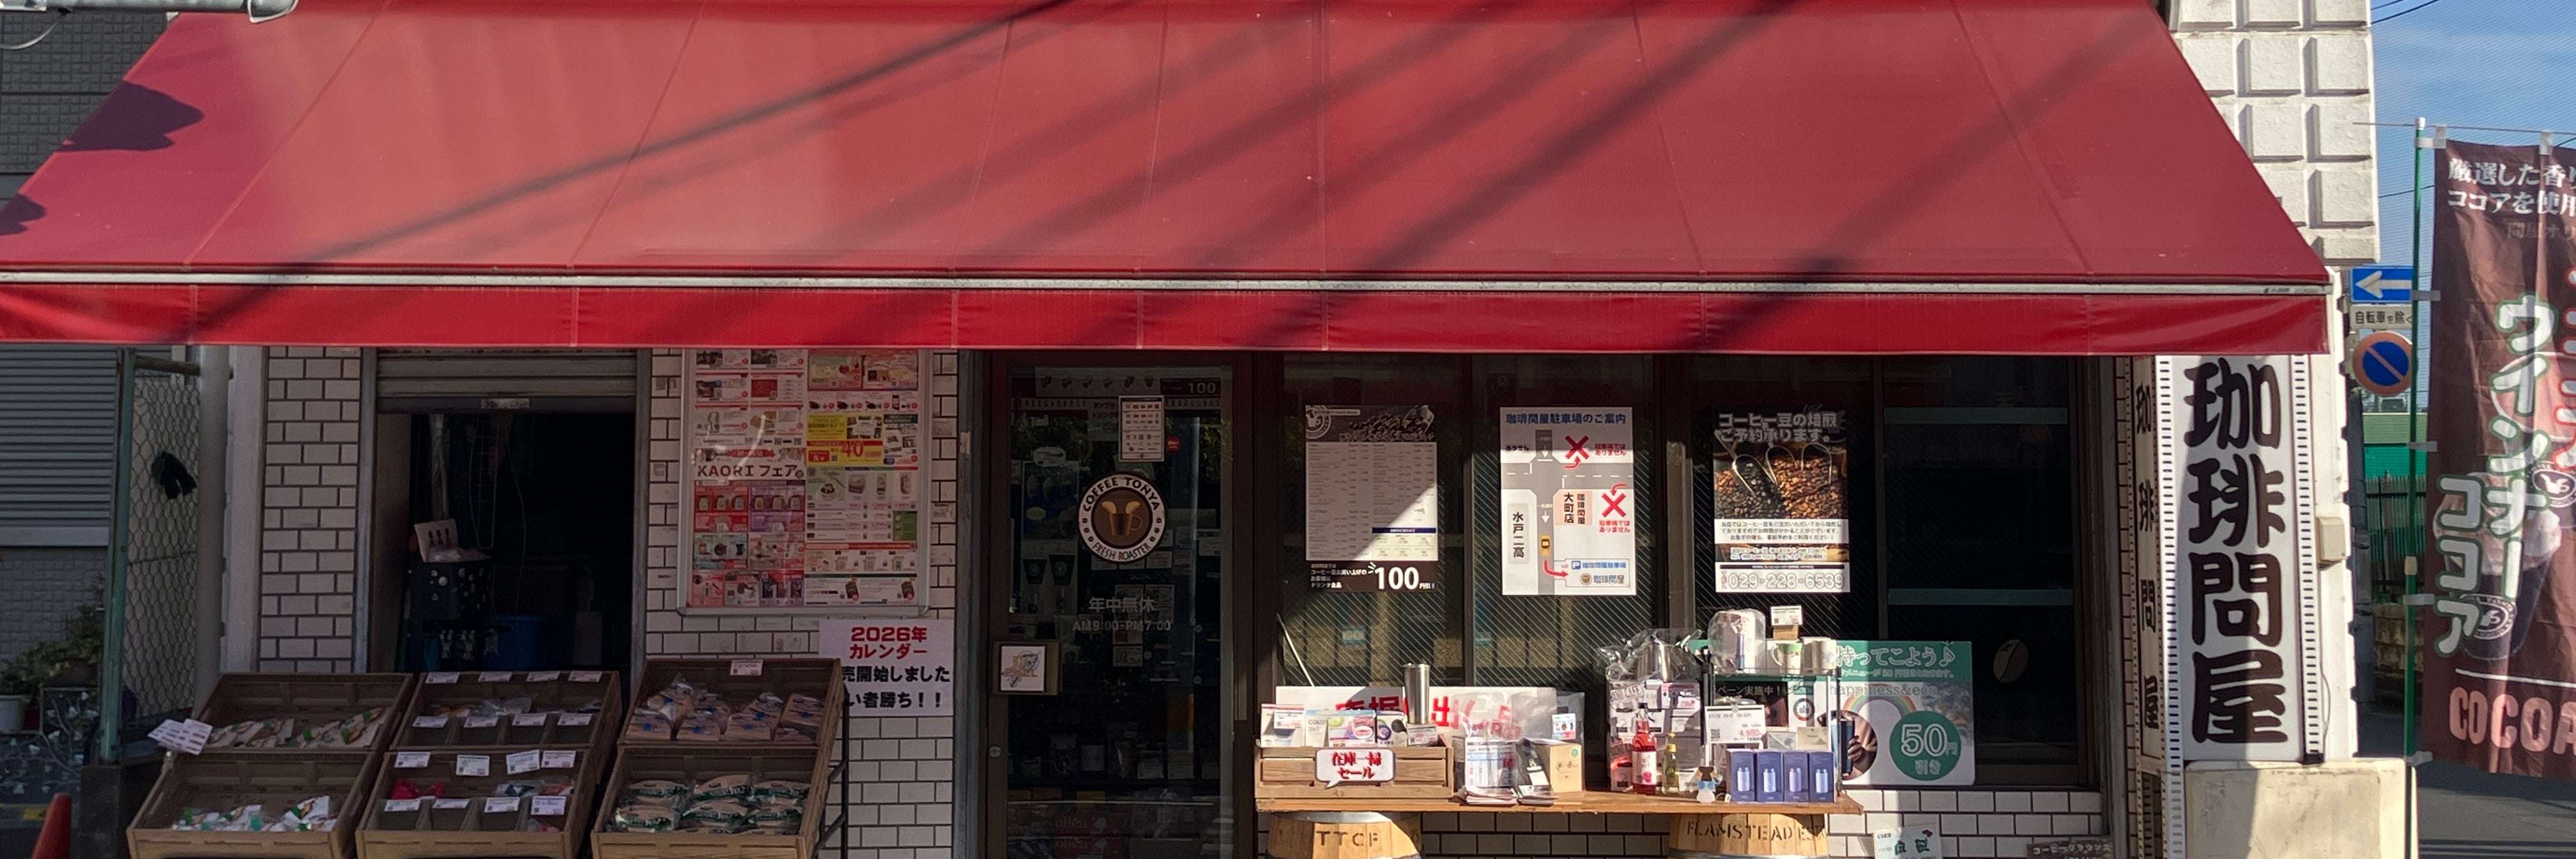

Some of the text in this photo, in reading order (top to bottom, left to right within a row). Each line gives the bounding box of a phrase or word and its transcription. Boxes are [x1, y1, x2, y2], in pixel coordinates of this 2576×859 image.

[2356, 311, 2412, 324] 自転車を除く
[1506, 413, 1626, 424] 珈琲問屋駐車場のご案内
[1719, 412, 1837, 428] コーヒー豆の焙煎
[698, 465, 798, 477] KAORI フェア
[1084, 477, 1161, 512] COFFEE TONYA
[1512, 512, 1525, 558] 水戸二高
[1092, 543, 1151, 560] FRESH ROASTER
[2182, 357, 2288, 743] 珈琲問屋
[2437, 476, 2483, 656] ココア
[1375, 566, 1420, 590] 100
[1089, 596, 1155, 614] 年中無休
[851, 626, 928, 642] 2026年
[850, 643, 928, 660] カレンダー
[2449, 686, 2576, 755] COCOA
[1901, 724, 1947, 757] 50
[1337, 767, 1375, 779] セール
[1315, 830, 1379, 847] TTCF
